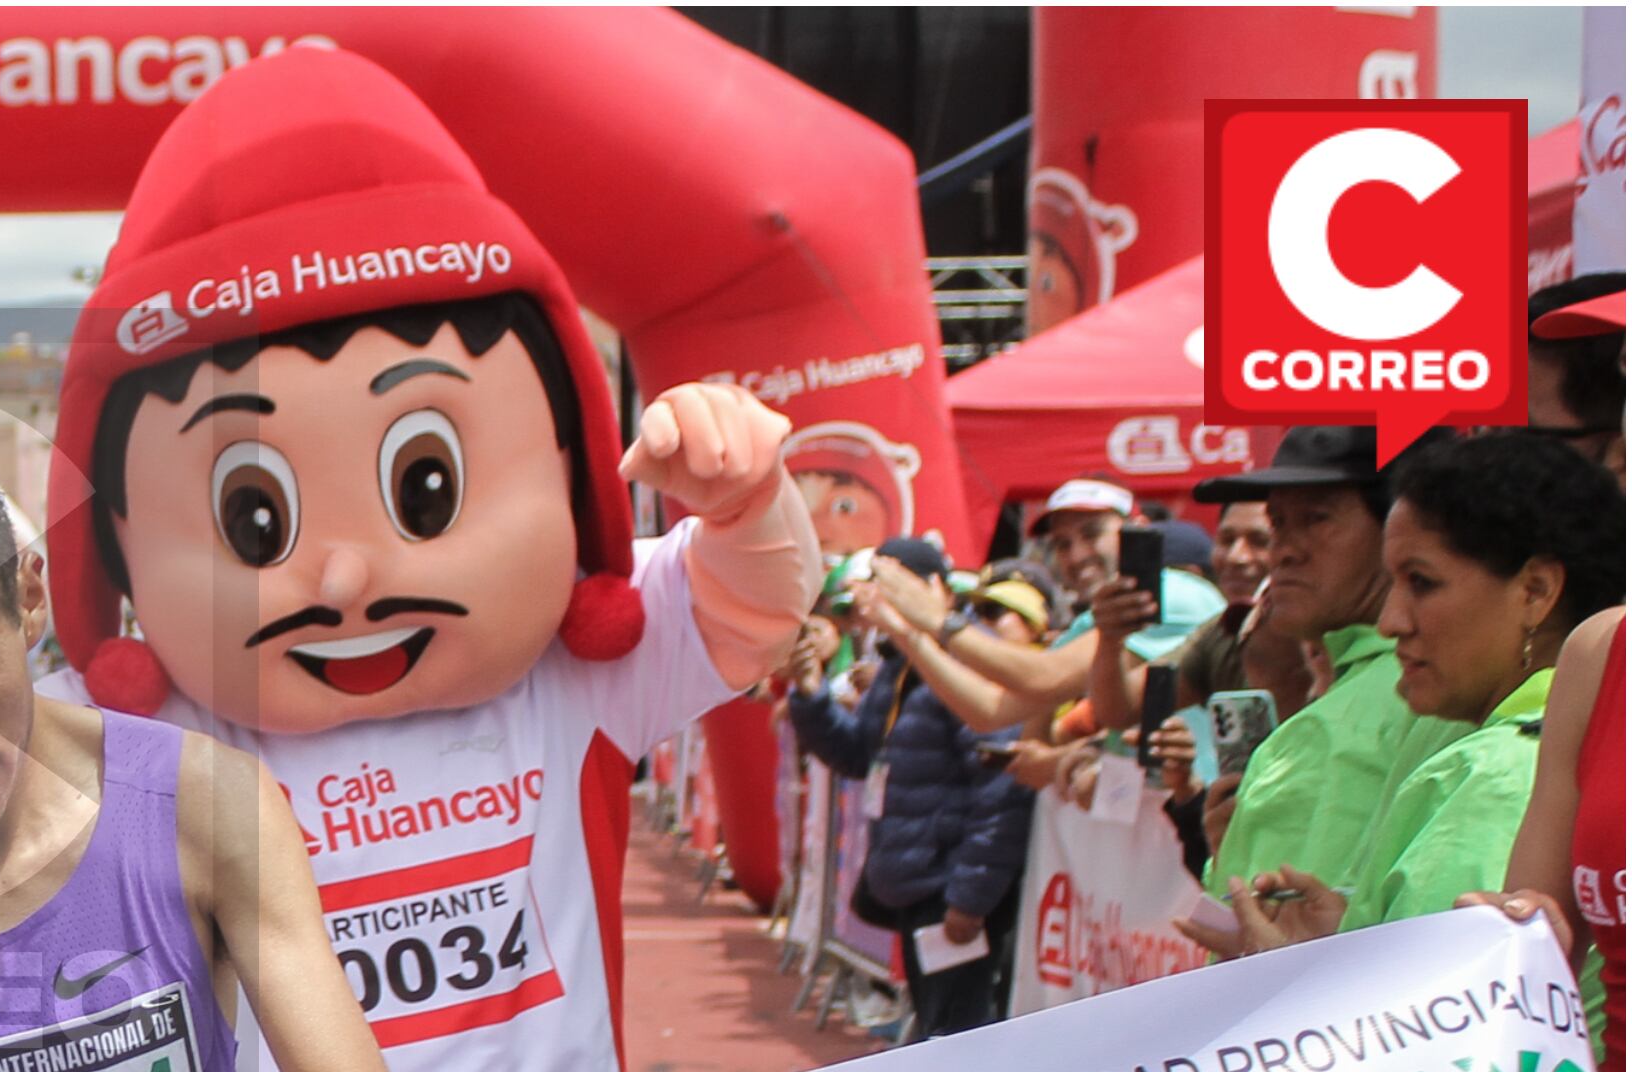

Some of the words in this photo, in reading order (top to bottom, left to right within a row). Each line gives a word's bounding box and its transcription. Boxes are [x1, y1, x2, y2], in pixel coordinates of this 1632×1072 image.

[186, 265, 281, 317] Caja
[291, 240, 512, 293] Huancayo
[1190, 421, 1255, 474] Ca
[318, 762, 397, 807] Caja
[321, 768, 545, 853] Huancayo
[329, 881, 509, 943] RTICIPANTE
[151, 1008, 178, 1040] DE
